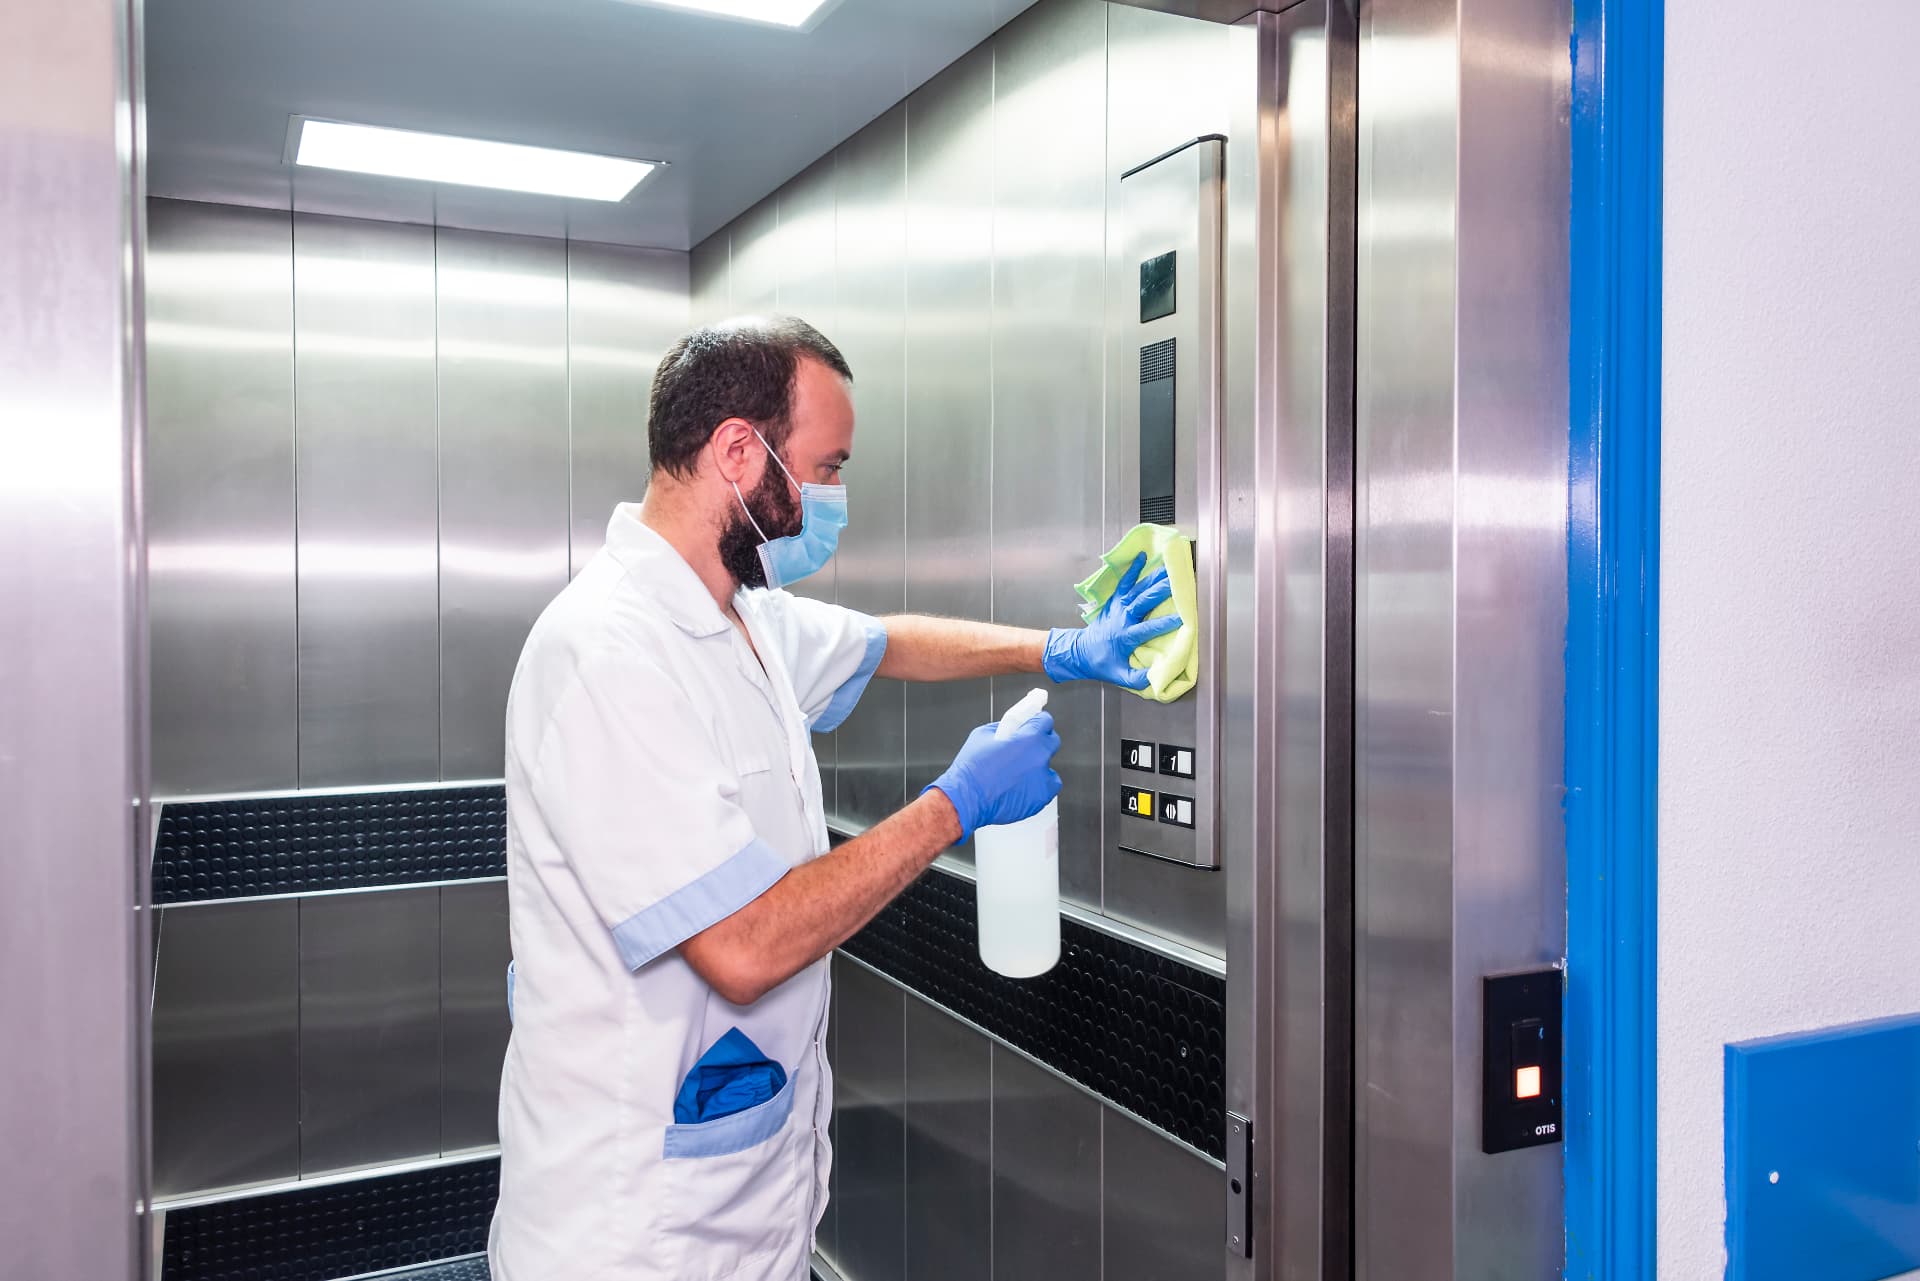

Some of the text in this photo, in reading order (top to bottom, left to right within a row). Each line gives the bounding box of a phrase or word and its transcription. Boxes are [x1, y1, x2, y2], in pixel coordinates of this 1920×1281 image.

[1130, 749, 1138, 765] 0
[1170, 755, 1177, 771] 1
[1535, 1123, 1556, 1136] OTIS
